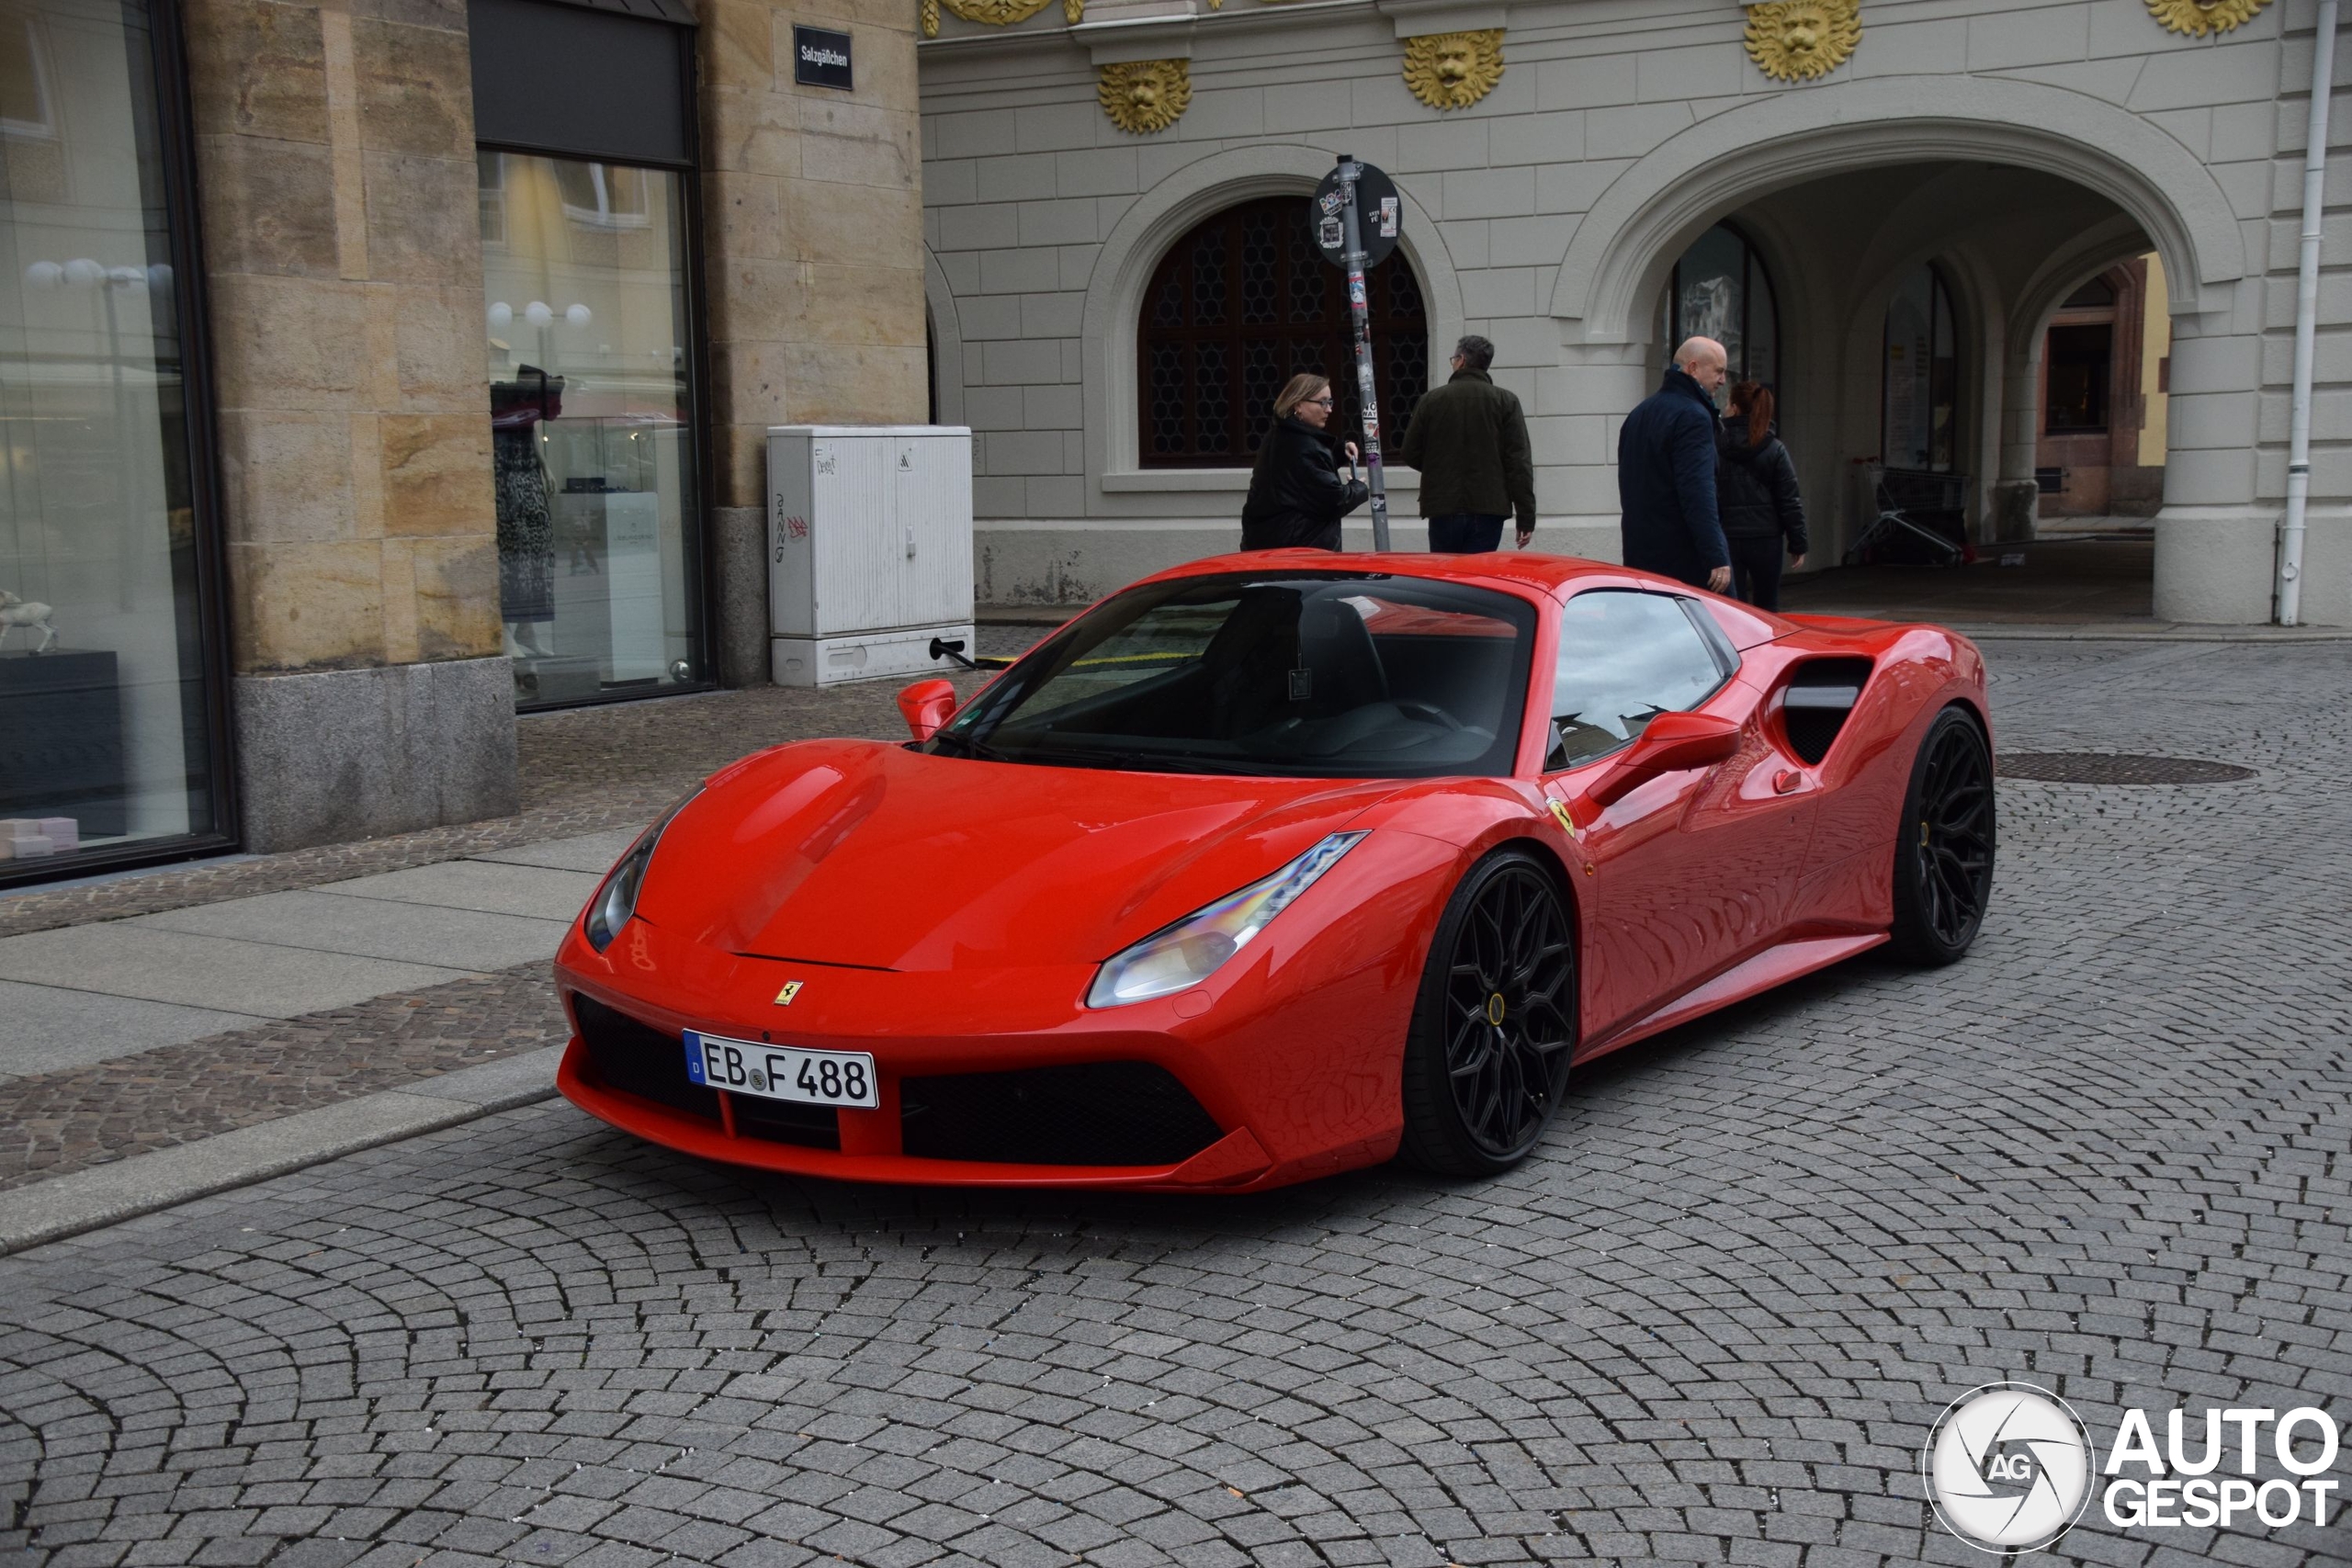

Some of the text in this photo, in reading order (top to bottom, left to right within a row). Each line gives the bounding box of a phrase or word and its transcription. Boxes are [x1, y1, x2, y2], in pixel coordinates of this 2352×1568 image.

[801, 45, 847, 67] Salzgäßchen
[693, 1062, 700, 1074] D
[704, 1043, 867, 1100] EB F 488
